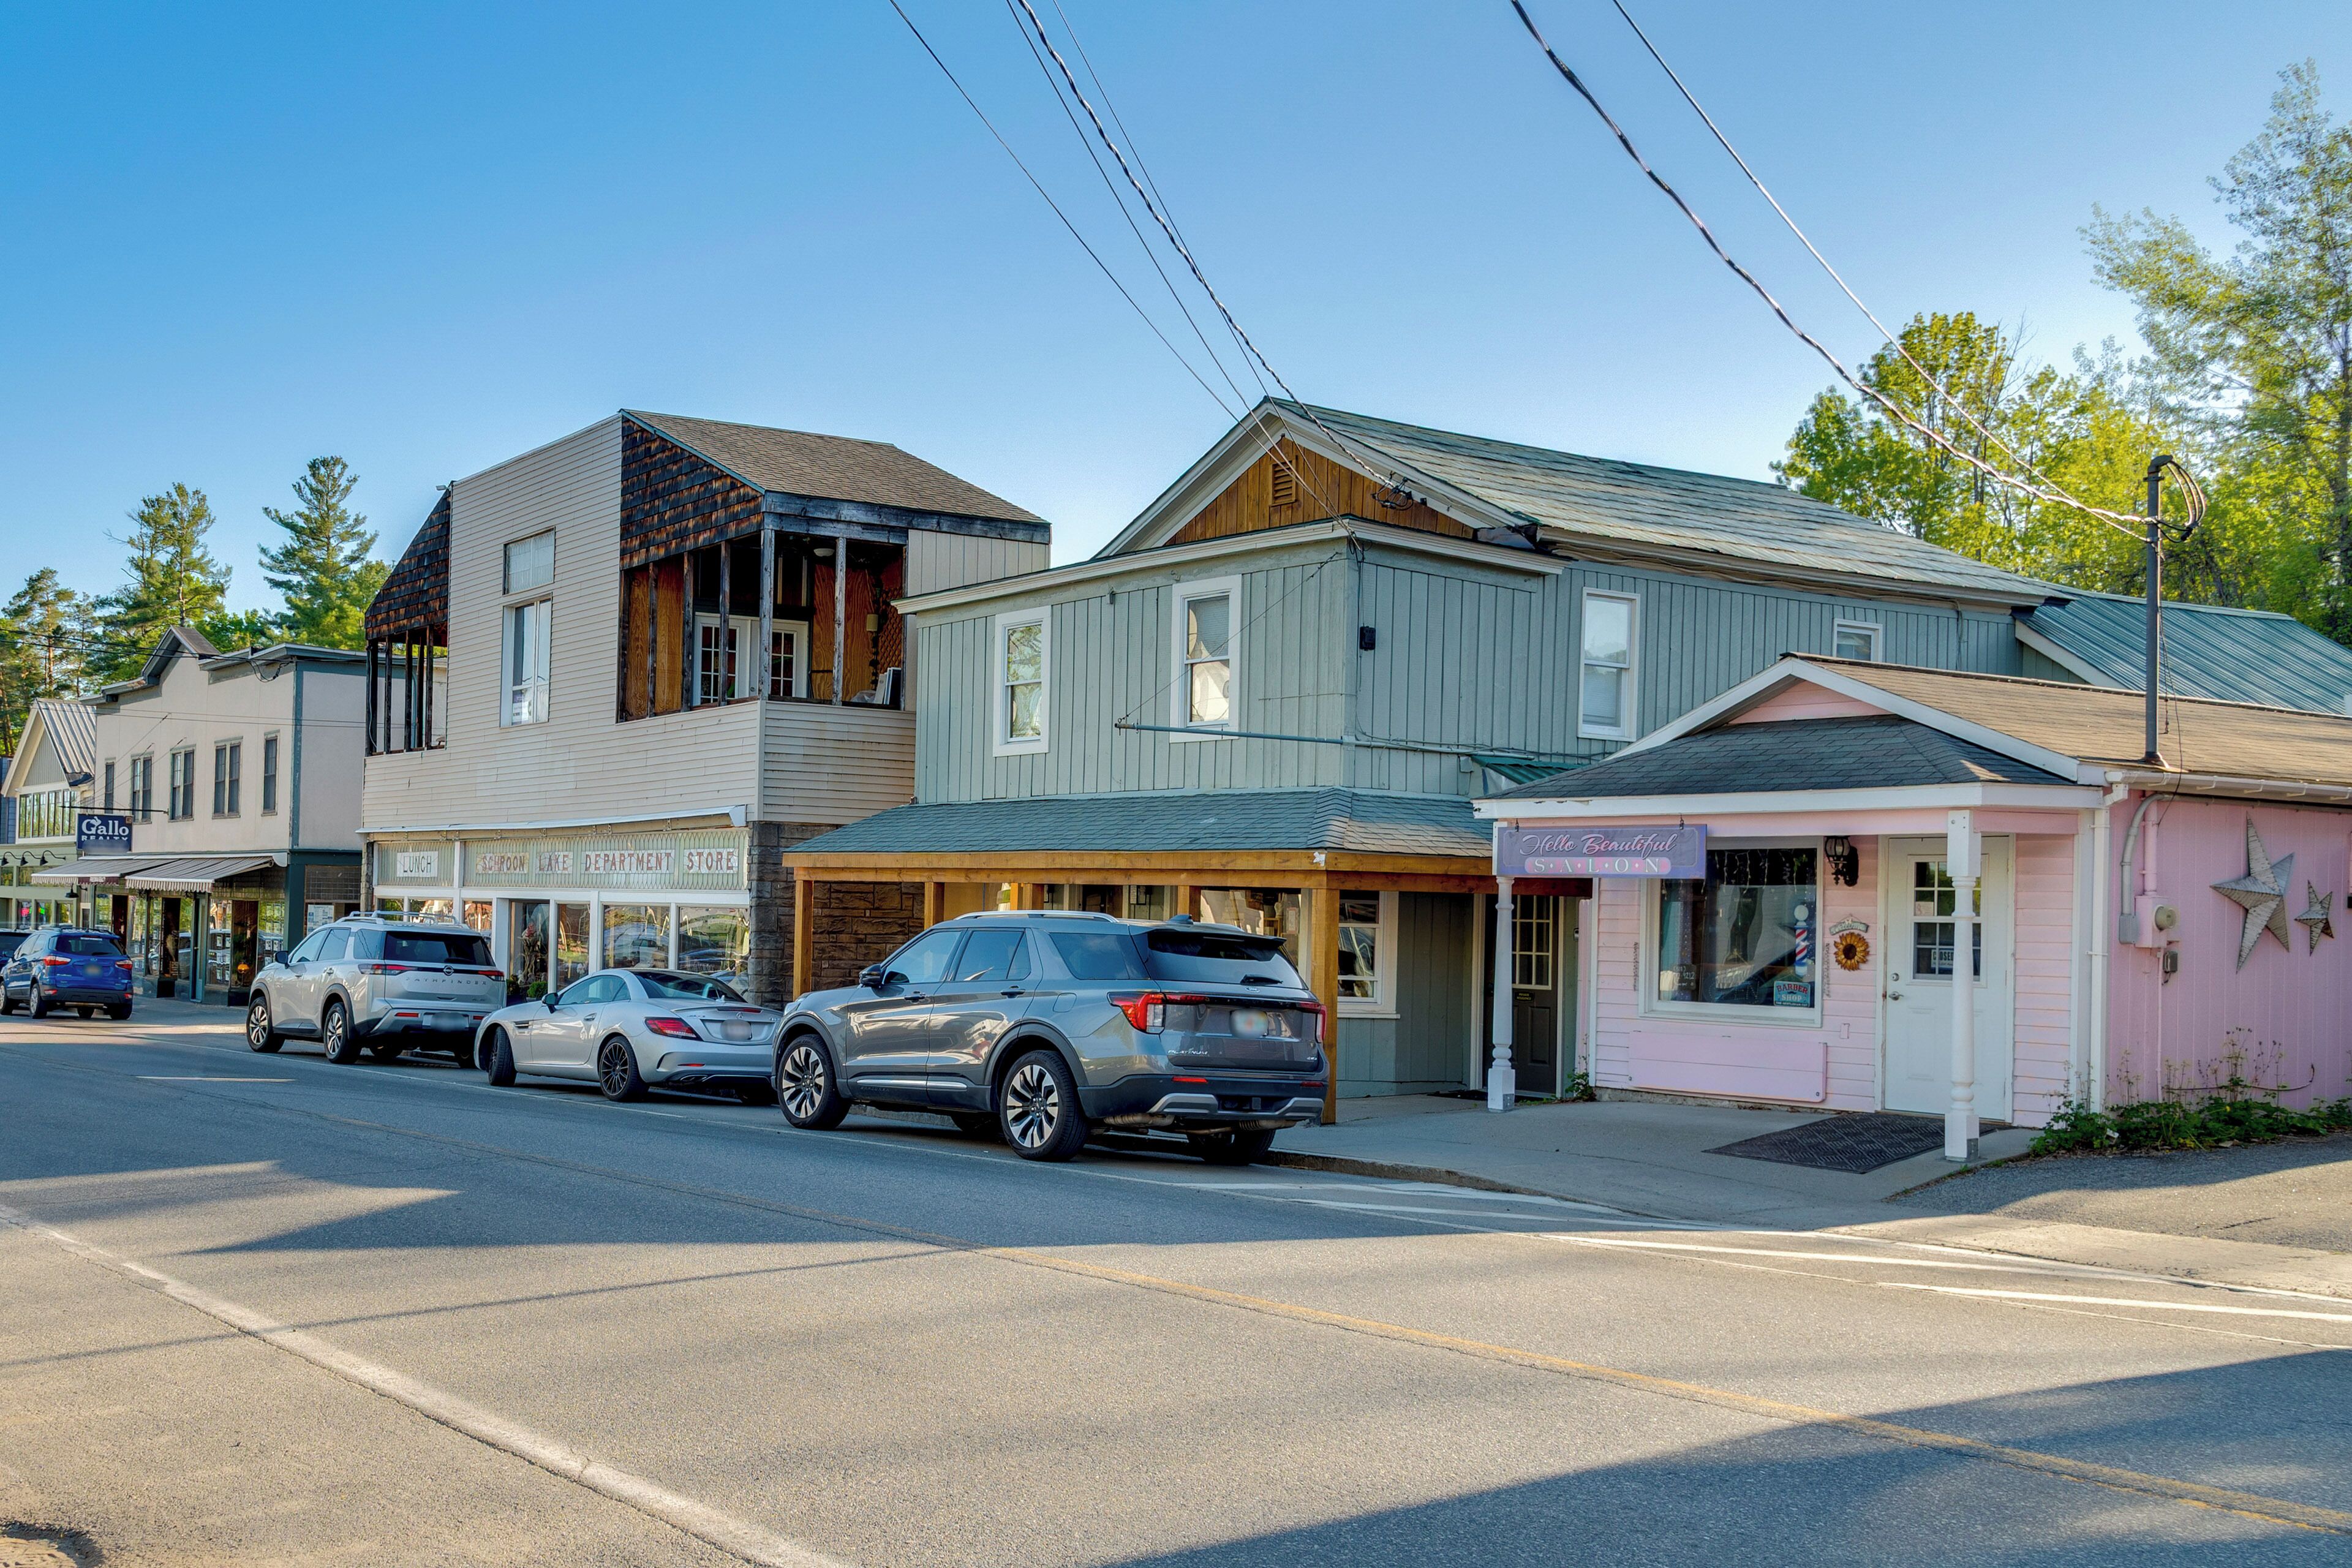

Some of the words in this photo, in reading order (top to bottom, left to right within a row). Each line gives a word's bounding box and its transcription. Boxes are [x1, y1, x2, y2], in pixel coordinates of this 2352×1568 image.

[81, 816, 129, 835] Gallo
[1520, 834, 1577, 856] Hello
[1581, 833, 1678, 859] Beautiful
[403, 856, 432, 873] LUNCH
[481, 855, 525, 872] SCHROON
[538, 854, 570, 872] LAKE
[585, 852, 671, 872] DEPARTMENT
[687, 851, 734, 871] STORE
[1534, 858, 1660, 873] SALON
[1932, 951, 1954, 961] COSED
[1776, 983, 1808, 994] BARBER
